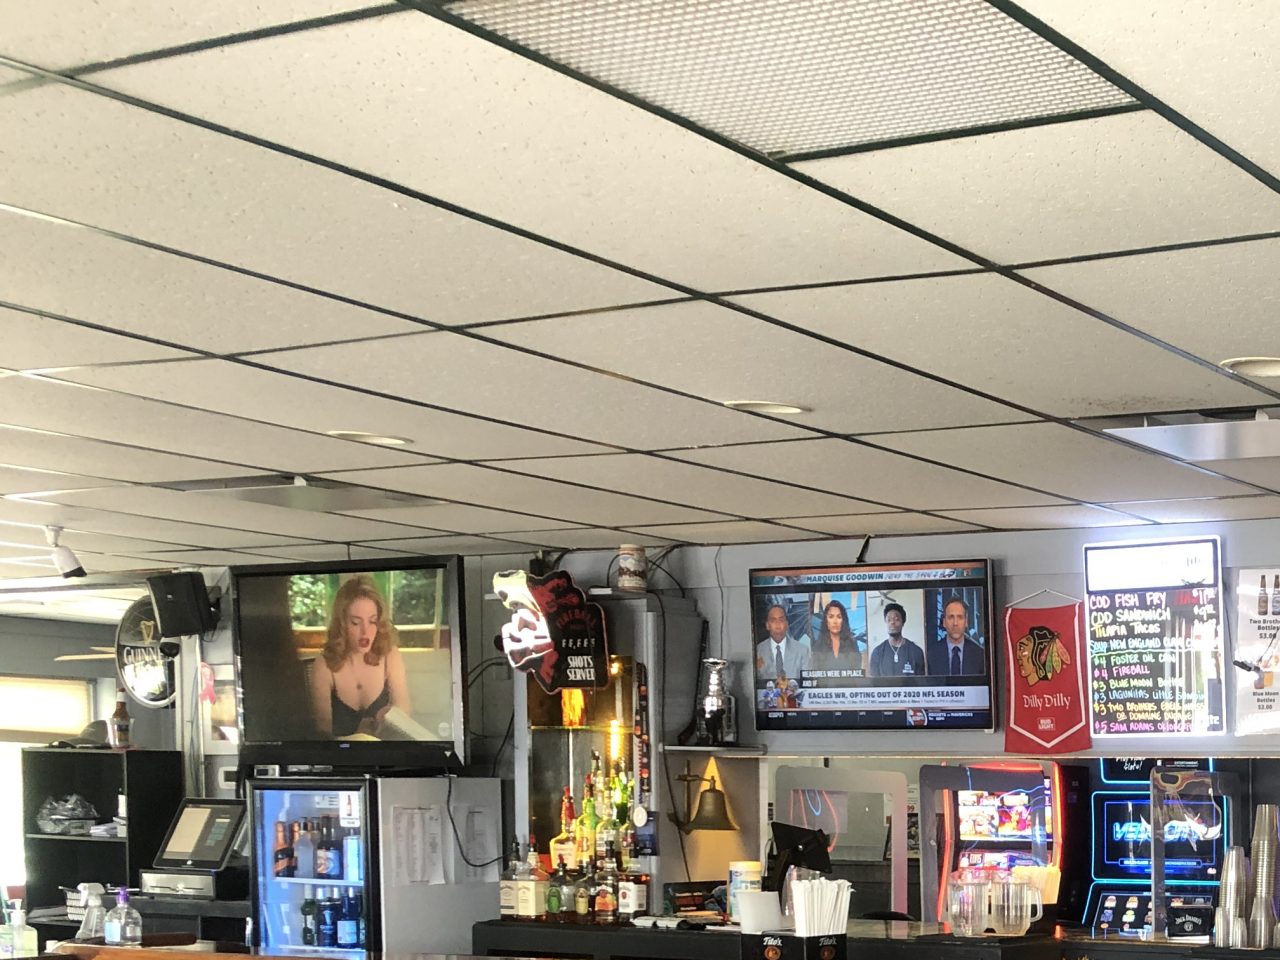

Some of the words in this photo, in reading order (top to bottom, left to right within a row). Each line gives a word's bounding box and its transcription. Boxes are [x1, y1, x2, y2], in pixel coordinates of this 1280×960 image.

[806, 574, 845, 584] MARQUISE
[845, 573, 884, 582] GOODWIN
[1089, 595, 1111, 610] COD
[1114, 593, 1140, 608] FISH
[1145, 591, 1167, 609] FRY
[1091, 611, 1113, 626] COD
[1109, 638, 1128, 651] NEW
[1127, 637, 1162, 650] ENGLAND
[567, 655, 594, 668] SHOTS
[1093, 655, 1106, 668] $4
[1110, 653, 1140, 666] FOSTER
[826, 670, 841, 678] WERE
[841, 670, 848, 678] IN
[1094, 668, 1109, 681] $4
[1112, 664, 1151, 678] FIREBALL
[1093, 680, 1107, 692] $3
[1108, 678, 1129, 690] BLUE
[1130, 678, 1154, 689] MOON
[808, 691, 833, 700] EAGLES
[849, 691, 876, 699] OPTING
[876, 691, 892, 699] OUT
[922, 690, 936, 698] NFL
[937, 690, 965, 698] SEASON
[1093, 692, 1107, 704] $3
[1022, 694, 1044, 711] Dilly
[1043, 693, 1072, 710] Dilly
[1093, 702, 1107, 716] $3
[1126, 701, 1158, 713] BROTHERS
[1116, 712, 1128, 722] OR
[1095, 721, 1108, 734] $5
[1109, 721, 1128, 733] SAM
[1129, 721, 1155, 732] ADAMS
[1175, 916, 1186, 925] JACK
[762, 936, 783, 946] Tito's
[818, 936, 838, 946] Tito's
